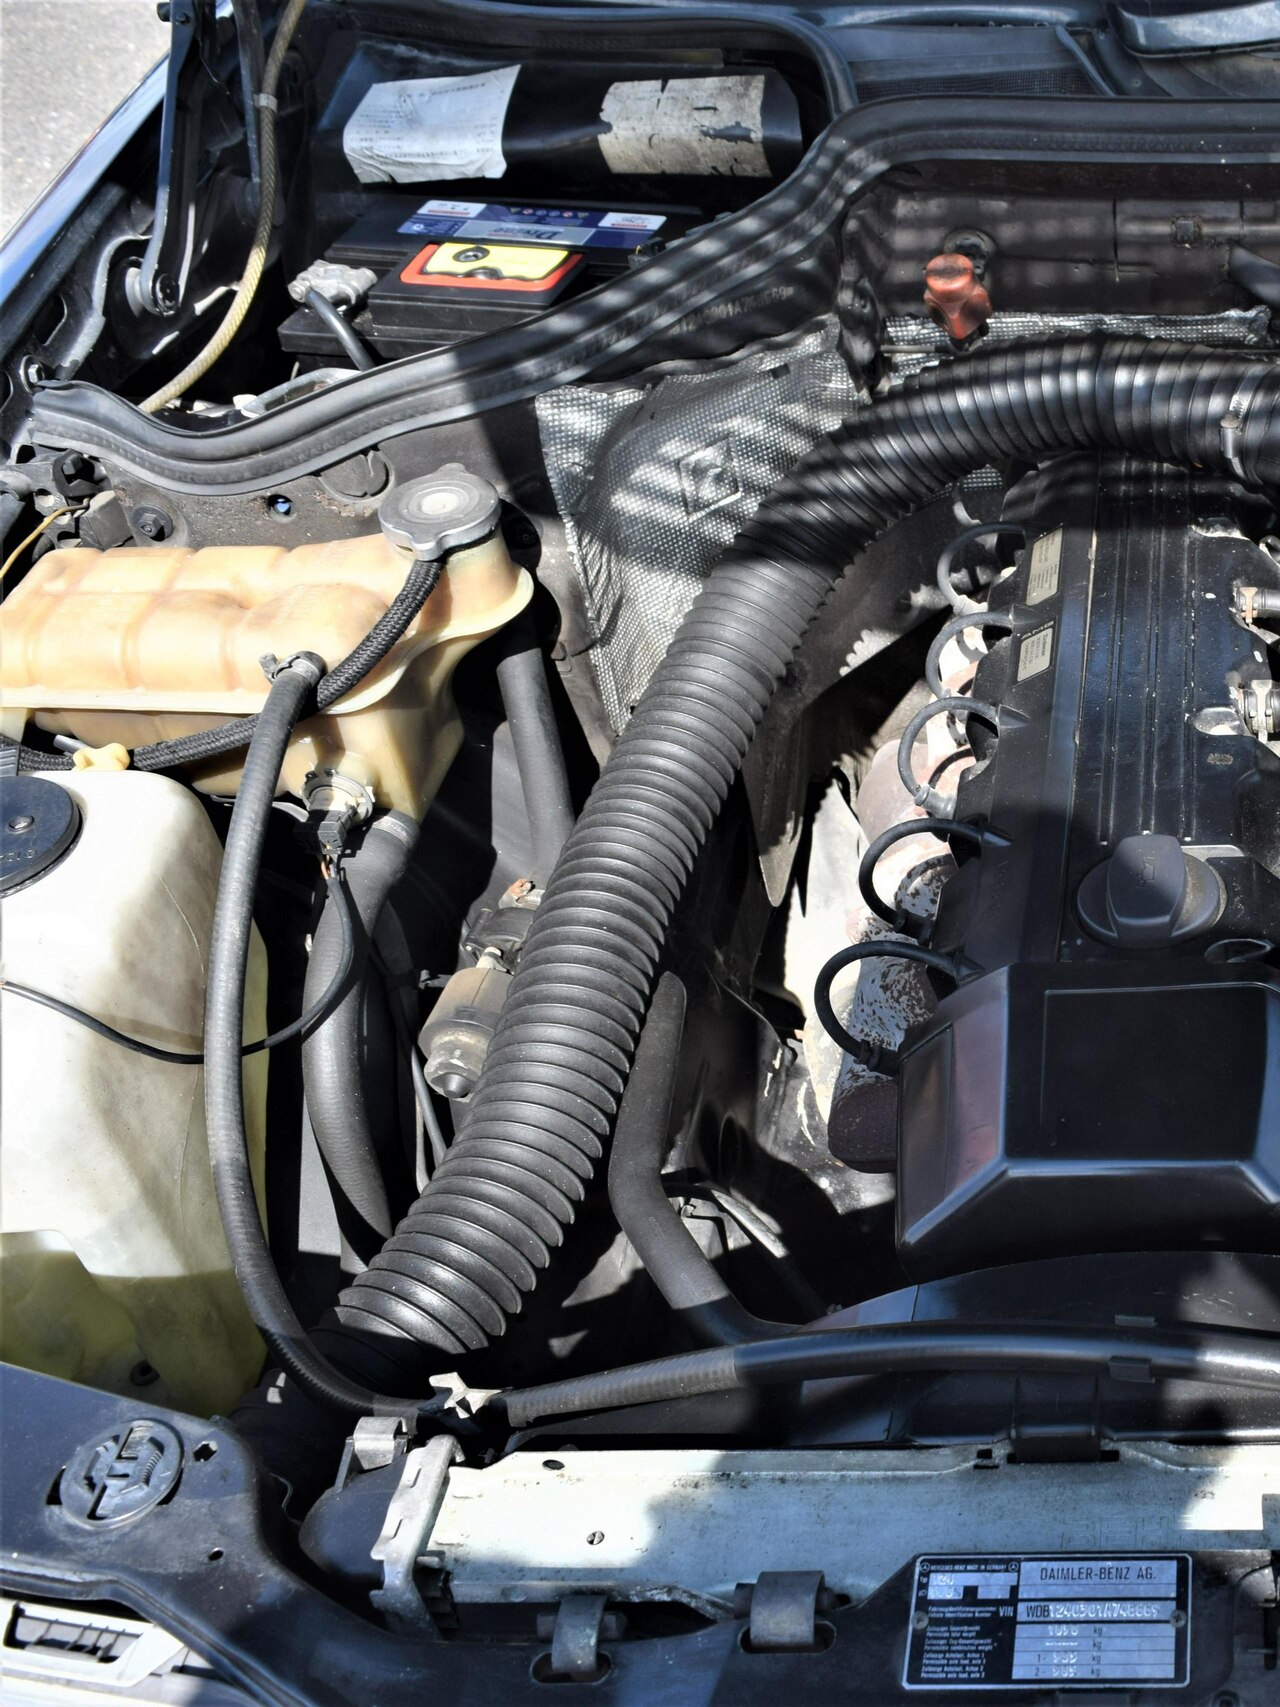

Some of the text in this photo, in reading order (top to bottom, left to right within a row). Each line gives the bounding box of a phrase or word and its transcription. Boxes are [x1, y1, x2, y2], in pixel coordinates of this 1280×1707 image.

[1040, 1567, 1157, 1581] DAIMLER-BENZ AG.
[999, 1606, 1014, 1617] VIN
